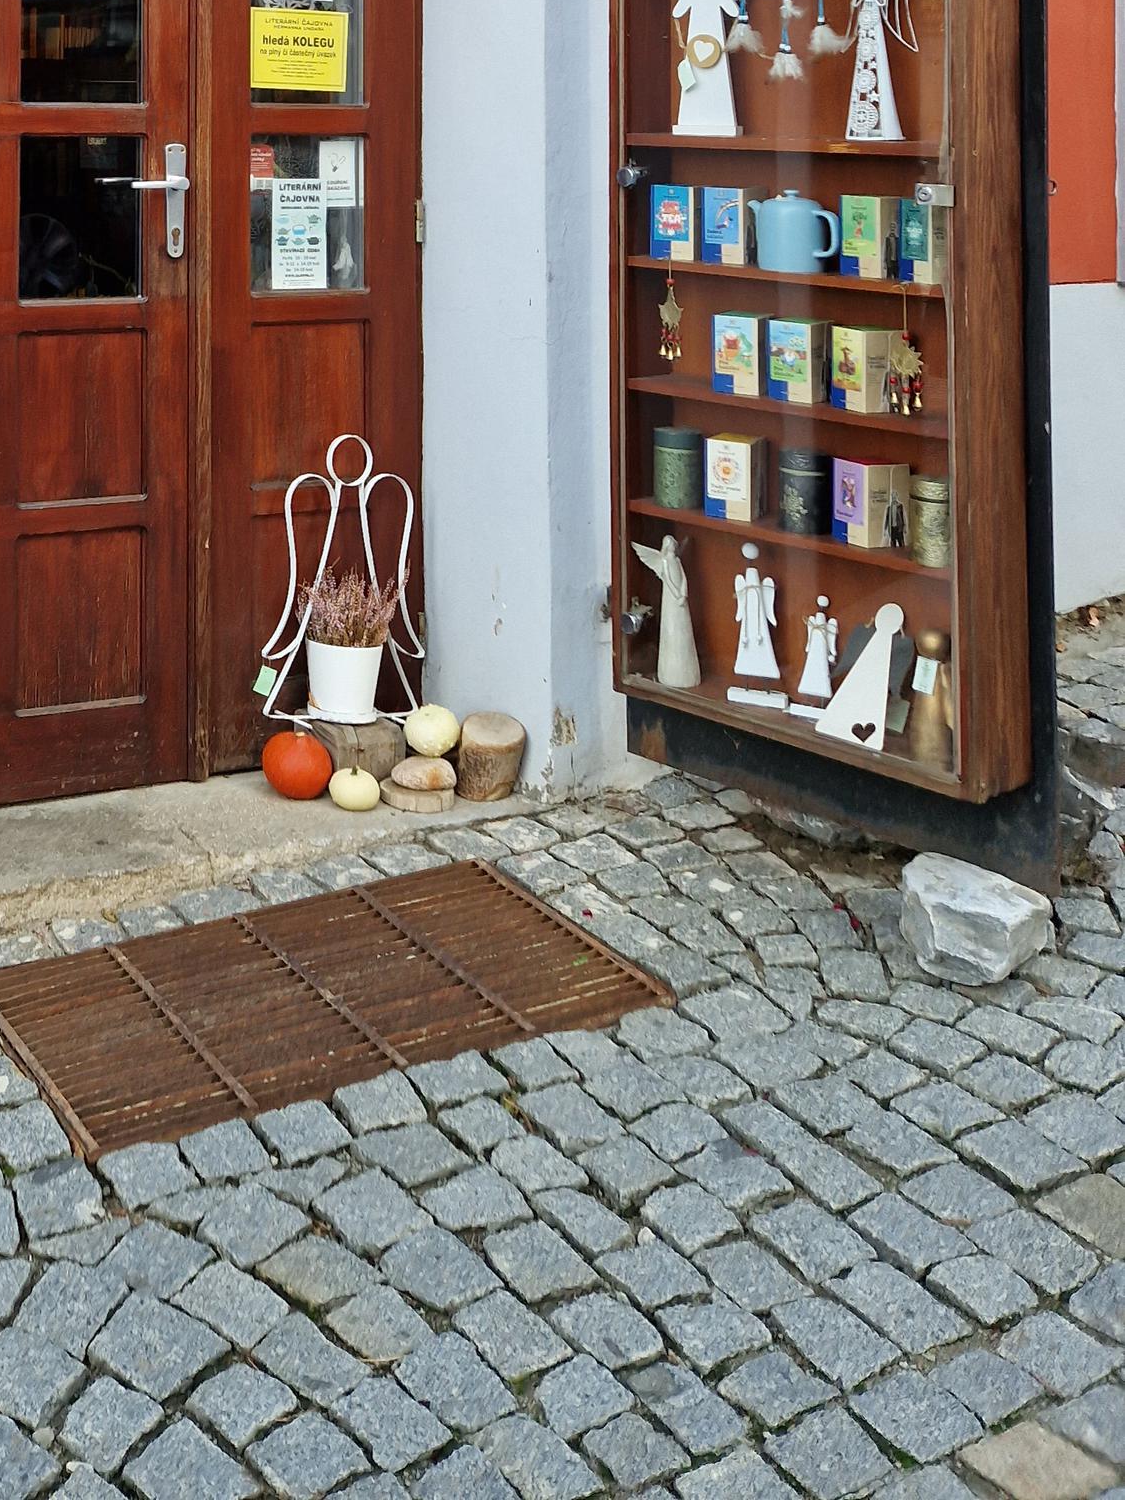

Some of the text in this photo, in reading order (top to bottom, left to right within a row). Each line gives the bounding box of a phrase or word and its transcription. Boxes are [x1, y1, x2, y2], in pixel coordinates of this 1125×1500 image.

[265, 18, 333, 27] LITERÁRNÍ ČAJOVNA
[262, 35, 335, 48] hledá KOLEGU
[289, 49, 315, 58] částečný
[279, 182, 321, 191] LITERÁRNÍ
[279, 195, 321, 203] ČAJOVNA
